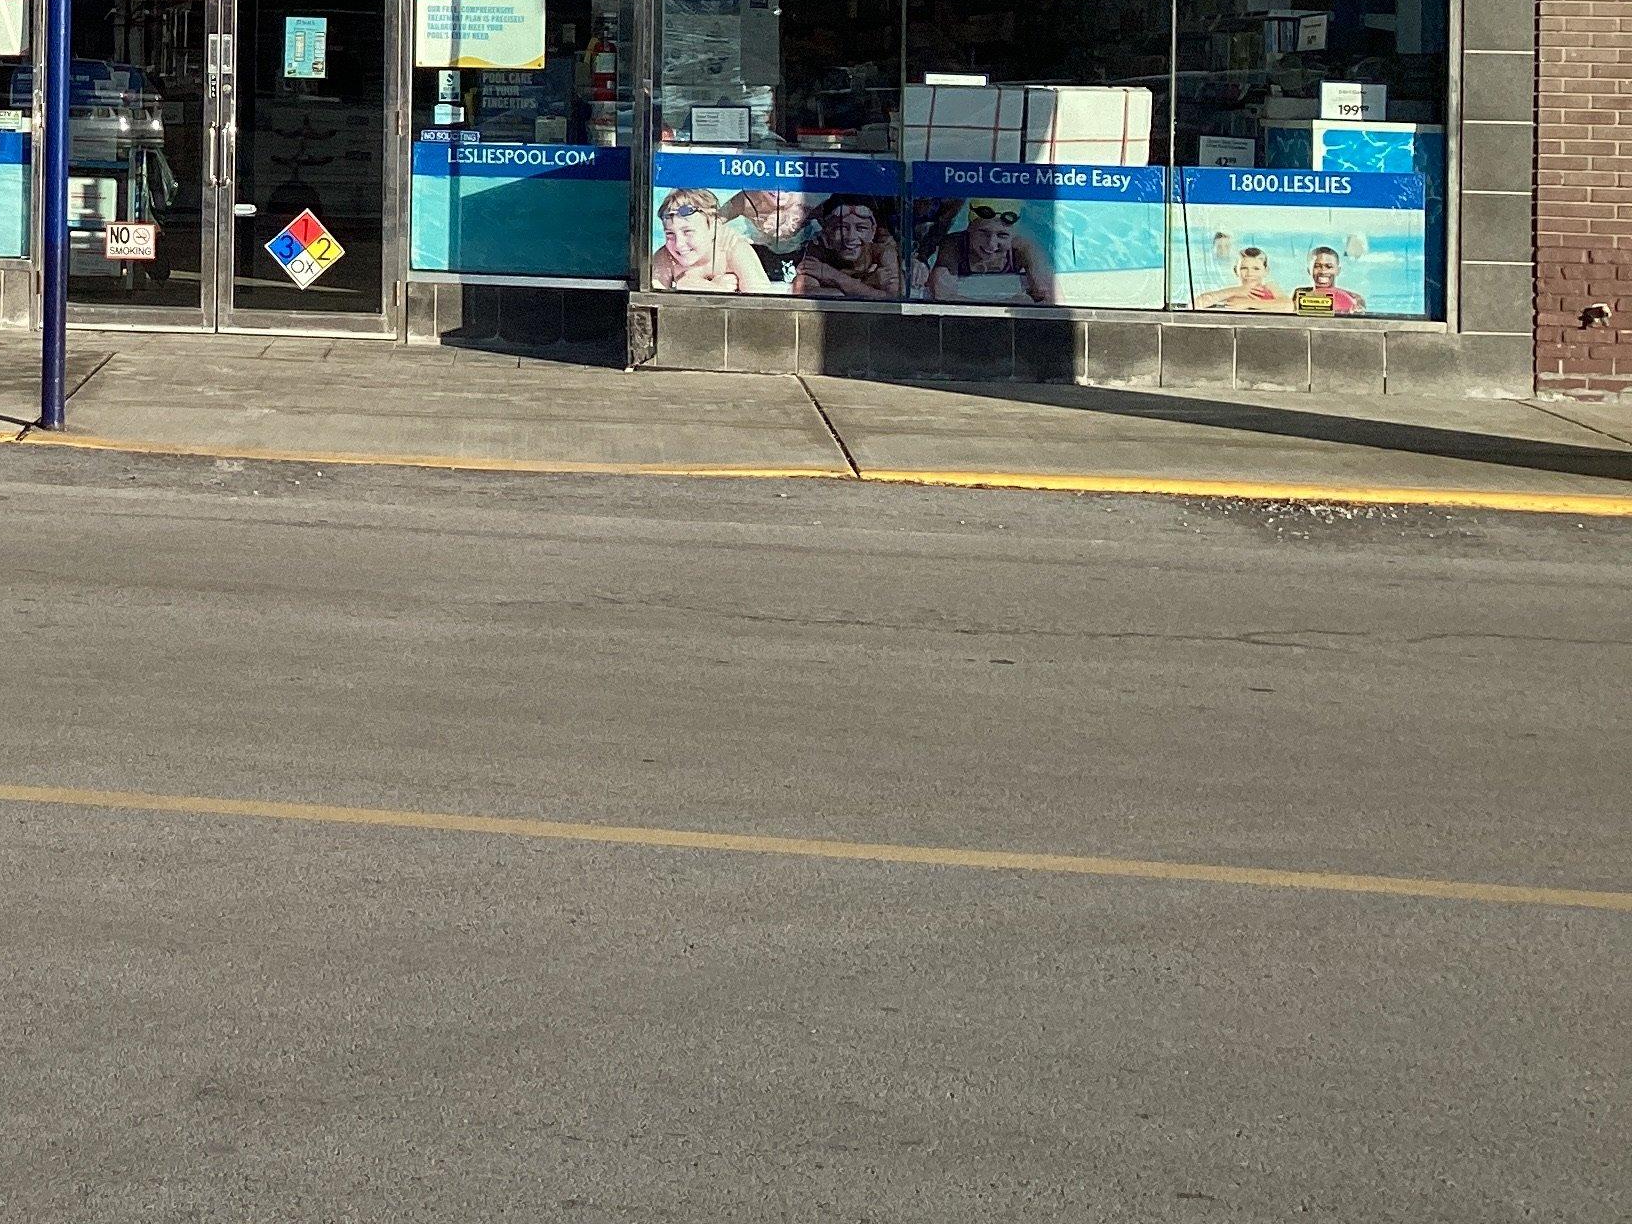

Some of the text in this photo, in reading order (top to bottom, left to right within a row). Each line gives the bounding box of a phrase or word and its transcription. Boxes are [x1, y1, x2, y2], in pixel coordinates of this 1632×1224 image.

[482, 72, 506, 84] POOL
[423, 132, 435, 140] NO
[447, 148, 595, 166] LESLIESPOOL.COM
[719, 158, 840, 178] 1.800. LESLIES
[944, 166, 1131, 192] Pool Care Made Easy
[1229, 174, 1352, 194] 1.800.LESLIES
[110, 226, 130, 245] NO
[301, 218, 309, 242] 1
[109, 246, 152, 256] SMOKING
[278, 232, 294, 259] 3
[316, 237, 331, 261] 2
[290, 259, 315, 275] OX
